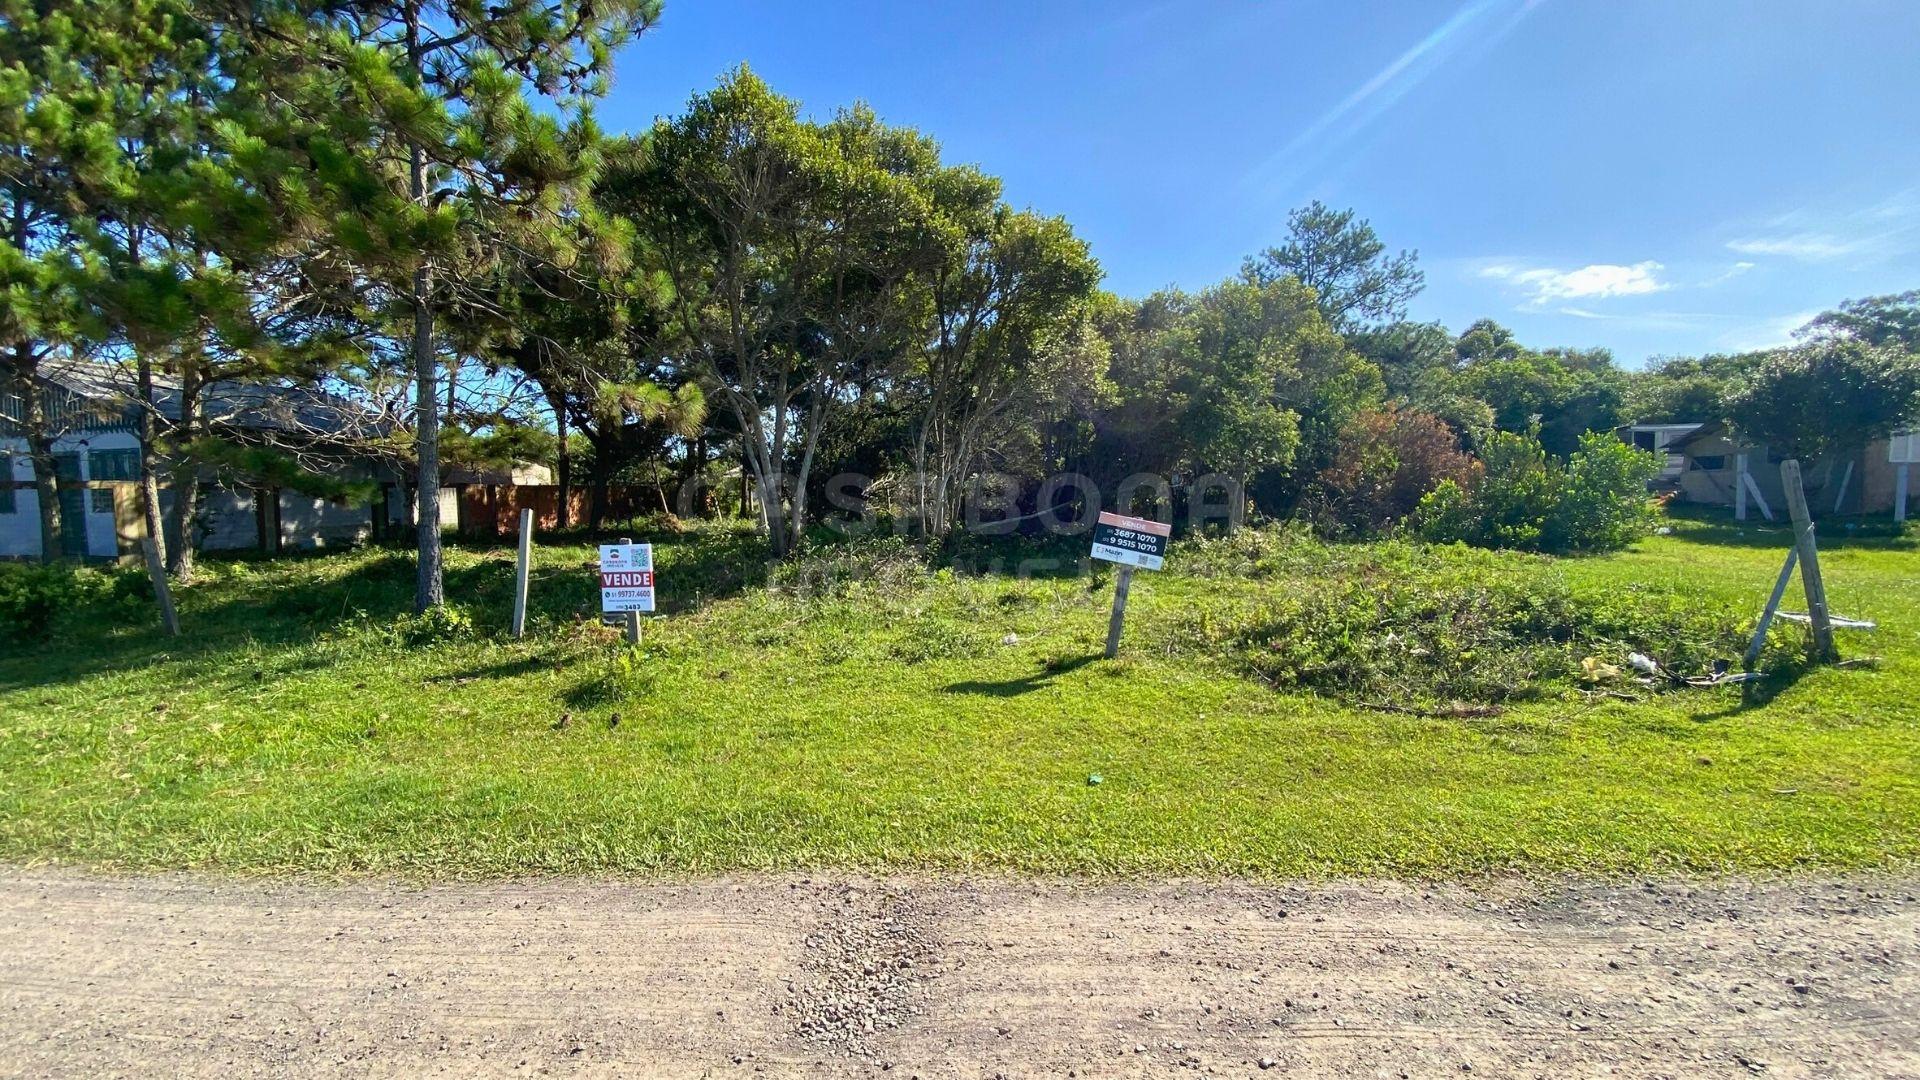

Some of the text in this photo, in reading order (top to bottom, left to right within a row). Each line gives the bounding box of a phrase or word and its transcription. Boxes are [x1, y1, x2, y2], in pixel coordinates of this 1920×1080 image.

[1121, 520, 1146, 531] VENDE
[1114, 529, 1136, 539] 3687
[1137, 533, 1157, 544] 1070
[1117, 538, 1136, 549] 9515
[1137, 542, 1157, 553] 1070
[603, 573, 651, 586] VENDE
